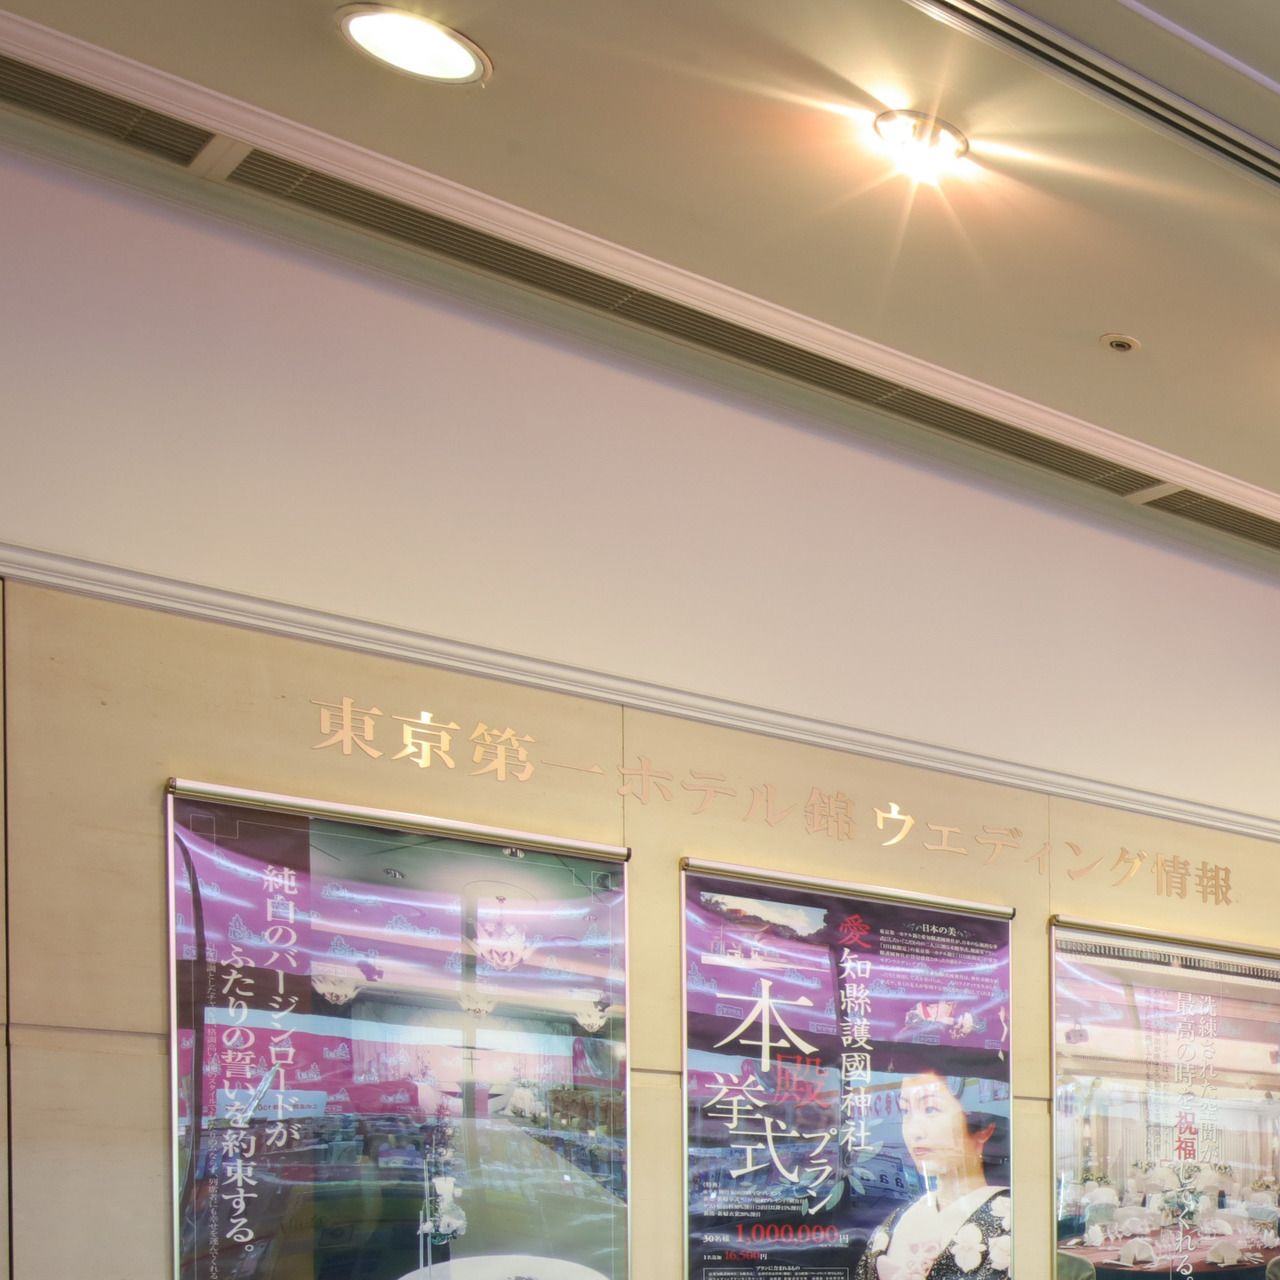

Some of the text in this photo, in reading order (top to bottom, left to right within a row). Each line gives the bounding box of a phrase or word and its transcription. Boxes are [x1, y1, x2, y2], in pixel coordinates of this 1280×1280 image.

[310, 695, 1233, 907] 東京第一ホテル錦 ウエディング情報
[262, 864, 301, 1148] 純白のバージンロードが
[838, 913, 874, 1153] 愛知縣護國神社
[922, 923, 957, 937] 日本の美
[220, 943, 257, 1253] ふたりの誓いを約束する。
[1198, 994, 1218, 1164] 洗練された空間が
[735, 1223, 849, 1245] 1,000,000円
